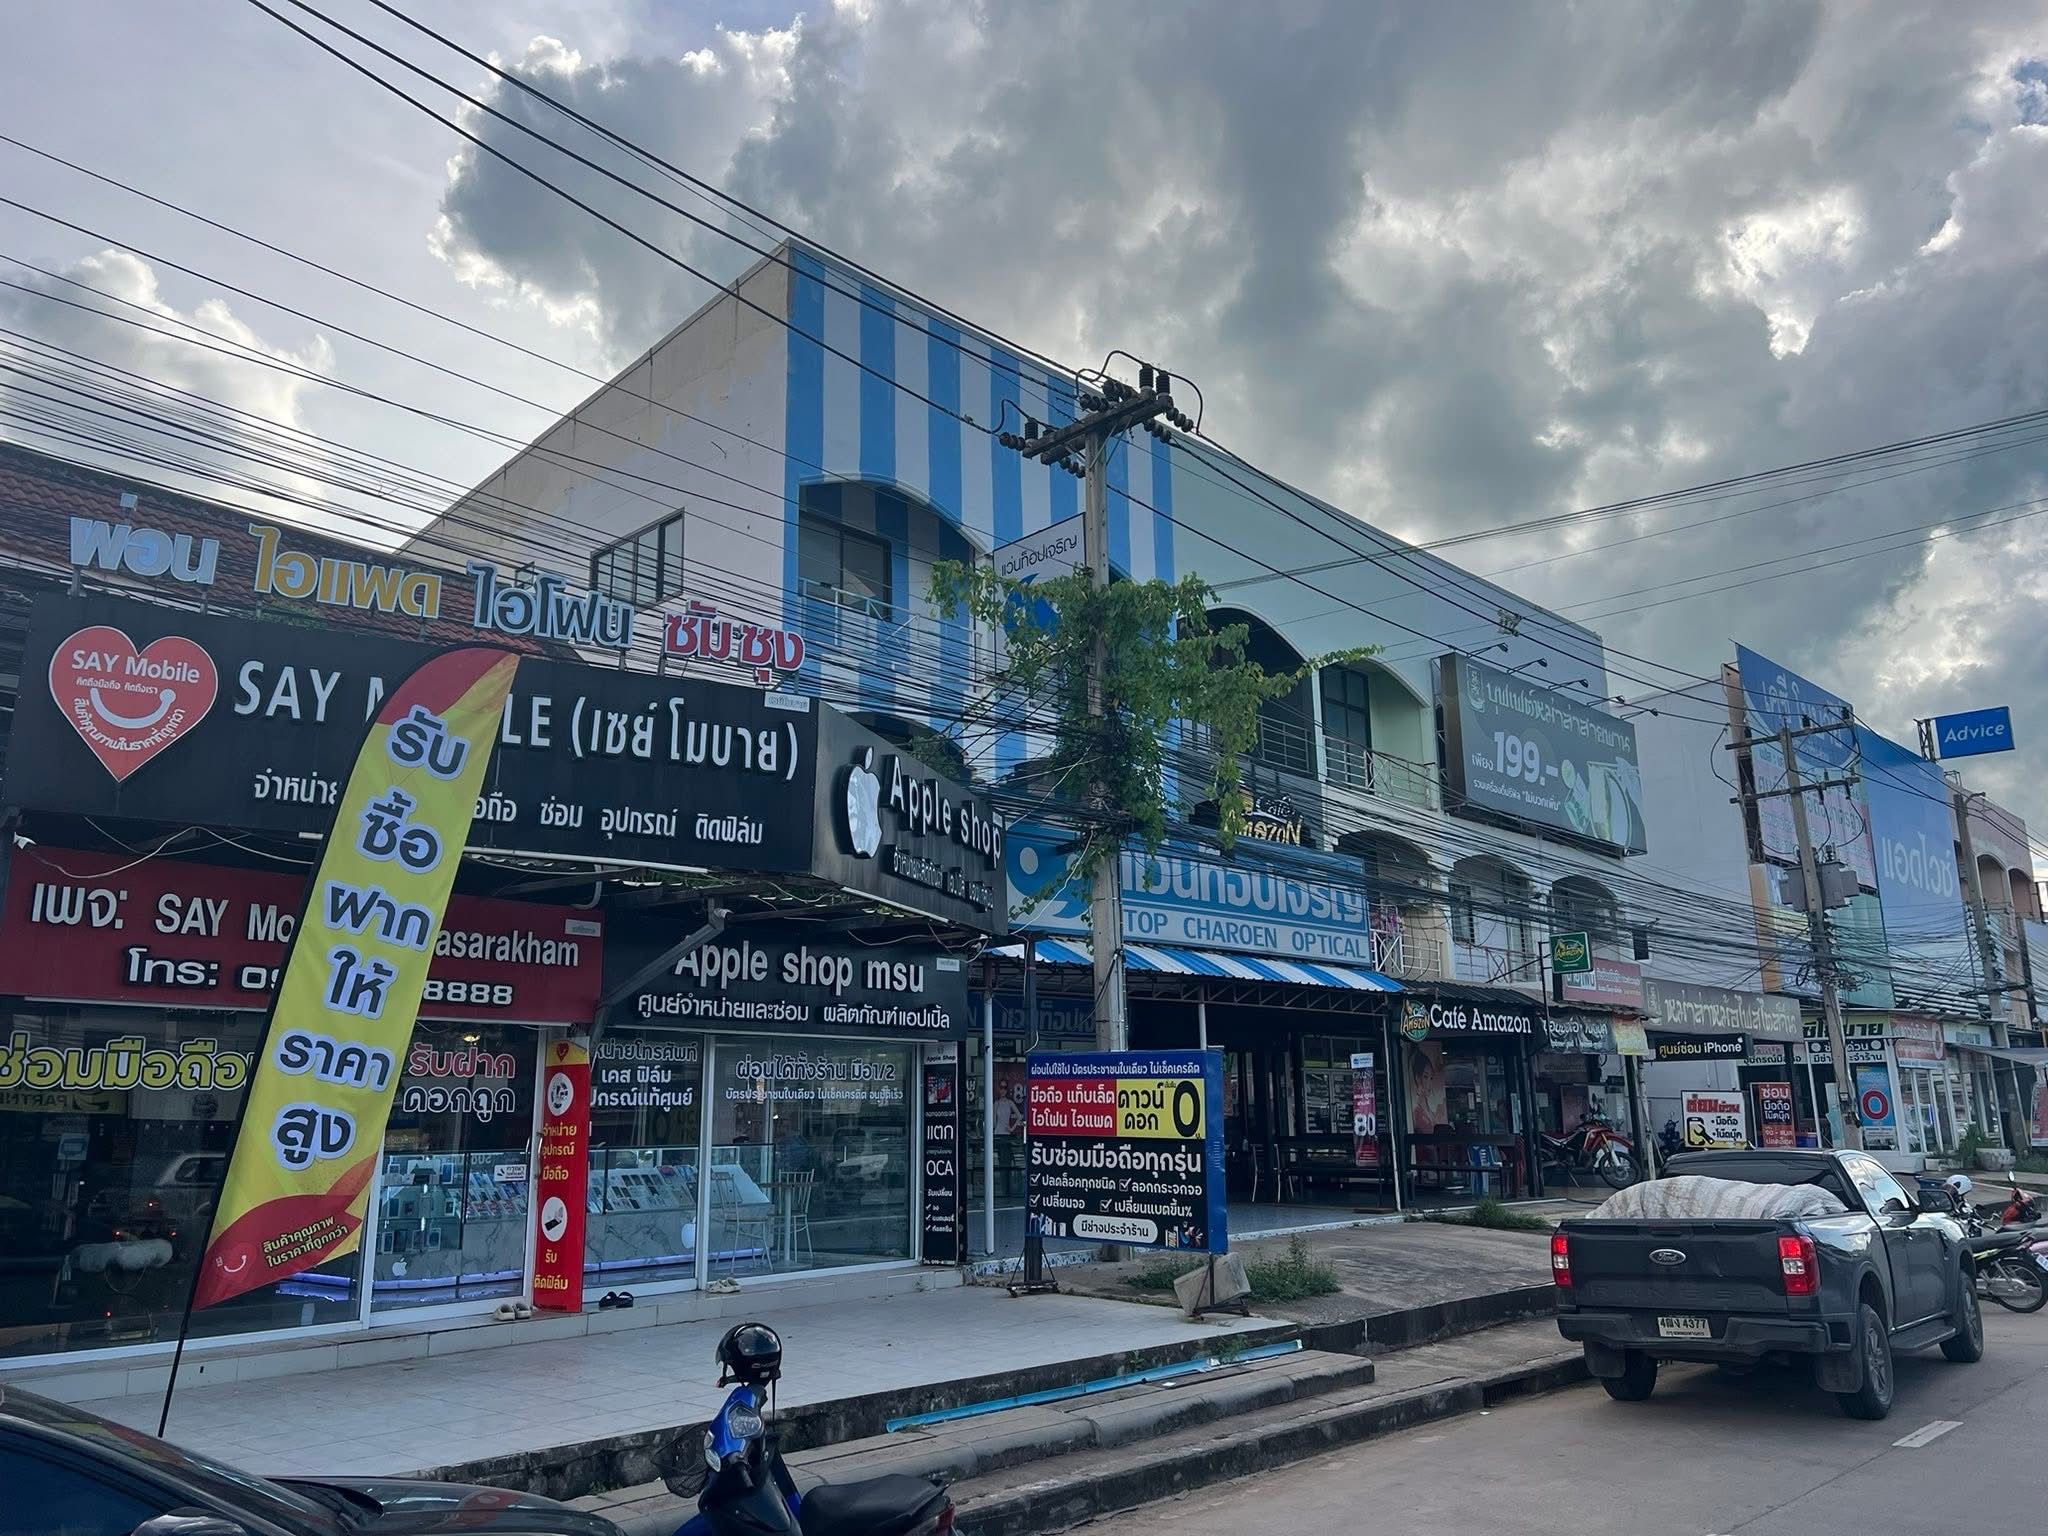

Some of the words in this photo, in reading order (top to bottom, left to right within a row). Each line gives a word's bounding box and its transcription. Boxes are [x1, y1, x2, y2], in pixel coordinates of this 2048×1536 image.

[249, 523, 441, 619] ไอแพด
[467, 561, 634, 648] ไอโฟน
[71, 649, 120, 673] SAY
[125, 656, 200, 684] Mobile
[234, 659, 342, 723] SAY
[390, 710, 467, 775] รับ
[1944, 722, 2005, 744] Advice
[363, 791, 438, 868] ซื้อ
[541, 796, 584, 828] ซ่อม
[601, 806, 679, 840] อุปกรณ์
[696, 813, 763, 845] ติดฟิล์ม
[890, 755, 951, 835] Apple
[960, 802, 1001, 868] shop
[31, 882, 128, 930] เพจ:
[154, 892, 229, 938] SAY
[435, 929, 579, 967] asarakham
[330, 886, 430, 946] ฝาก
[1123, 909, 1168, 935] TOP
[1183, 916, 1277, 949] CHAROEN
[1291, 931, 1367, 959] OPTICAL
[126, 946, 217, 986] โทร:
[330, 950, 394, 1014] ให้
[675, 940, 769, 989] Apple
[782, 945, 853, 996] shop
[867, 959, 924, 993] msu
[638, 992, 809, 1022] ศูนย์จำหน่ายและซ่อม
[823, 1003, 951, 1030] ผลิตภัณฑ์แอปเปิ้ล
[1430, 1003, 1467, 1030] Café
[1471, 1007, 1532, 1035] Amazon
[279, 1034, 391, 1087] ราคา
[408, 1042, 516, 1079] รับฝาก
[736, 1051, 847, 1081] ผ่อนได้ทั้งร้าน
[1659, 1041, 1702, 1058] ศูนย์ซ่อม
[1704, 1040, 1742, 1054] iPhone
[602, 1068, 631, 1083] เคส
[636, 1065, 672, 1084] ฟิล์ม
[1761, 1084, 1789, 1099] ซ่อม
[403, 1085, 516, 1123] ดอกถูก
[1031, 1086, 1063, 1104] มือถือ
[1067, 1084, 1115, 1104] แท็บเล็ต
[1117, 1082, 1165, 1110] ดาวน์
[1172, 1080, 1201, 1138] 0
[1031, 1108, 1068, 1128] ไอโฟน
[1070, 1108, 1113, 1129] ไอแพด
[1124, 1112, 1159, 1130] ดอก
[277, 1108, 352, 1164] สูง
[927, 1124, 954, 1140] แตก
[926, 1159, 954, 1176] OCA
[1031, 1140, 1201, 1180] รับซ่อมมือถือทุกรุ่น
[1042, 1191, 1086, 1209] เปลี่ยนจอ
[1131, 1180, 1203, 1196] ลอกกระจกจอ
[263, 1216, 334, 1253] สินค้าคุณภาพ
[265, 1225, 349, 1267] ในราคาที่ถูกกว่า
[1081, 1219, 1149, 1237] มีช่างประจำร้าน
[545, 1248, 558, 1264] รับ
[1683, 1318, 1706, 1329] 4377
